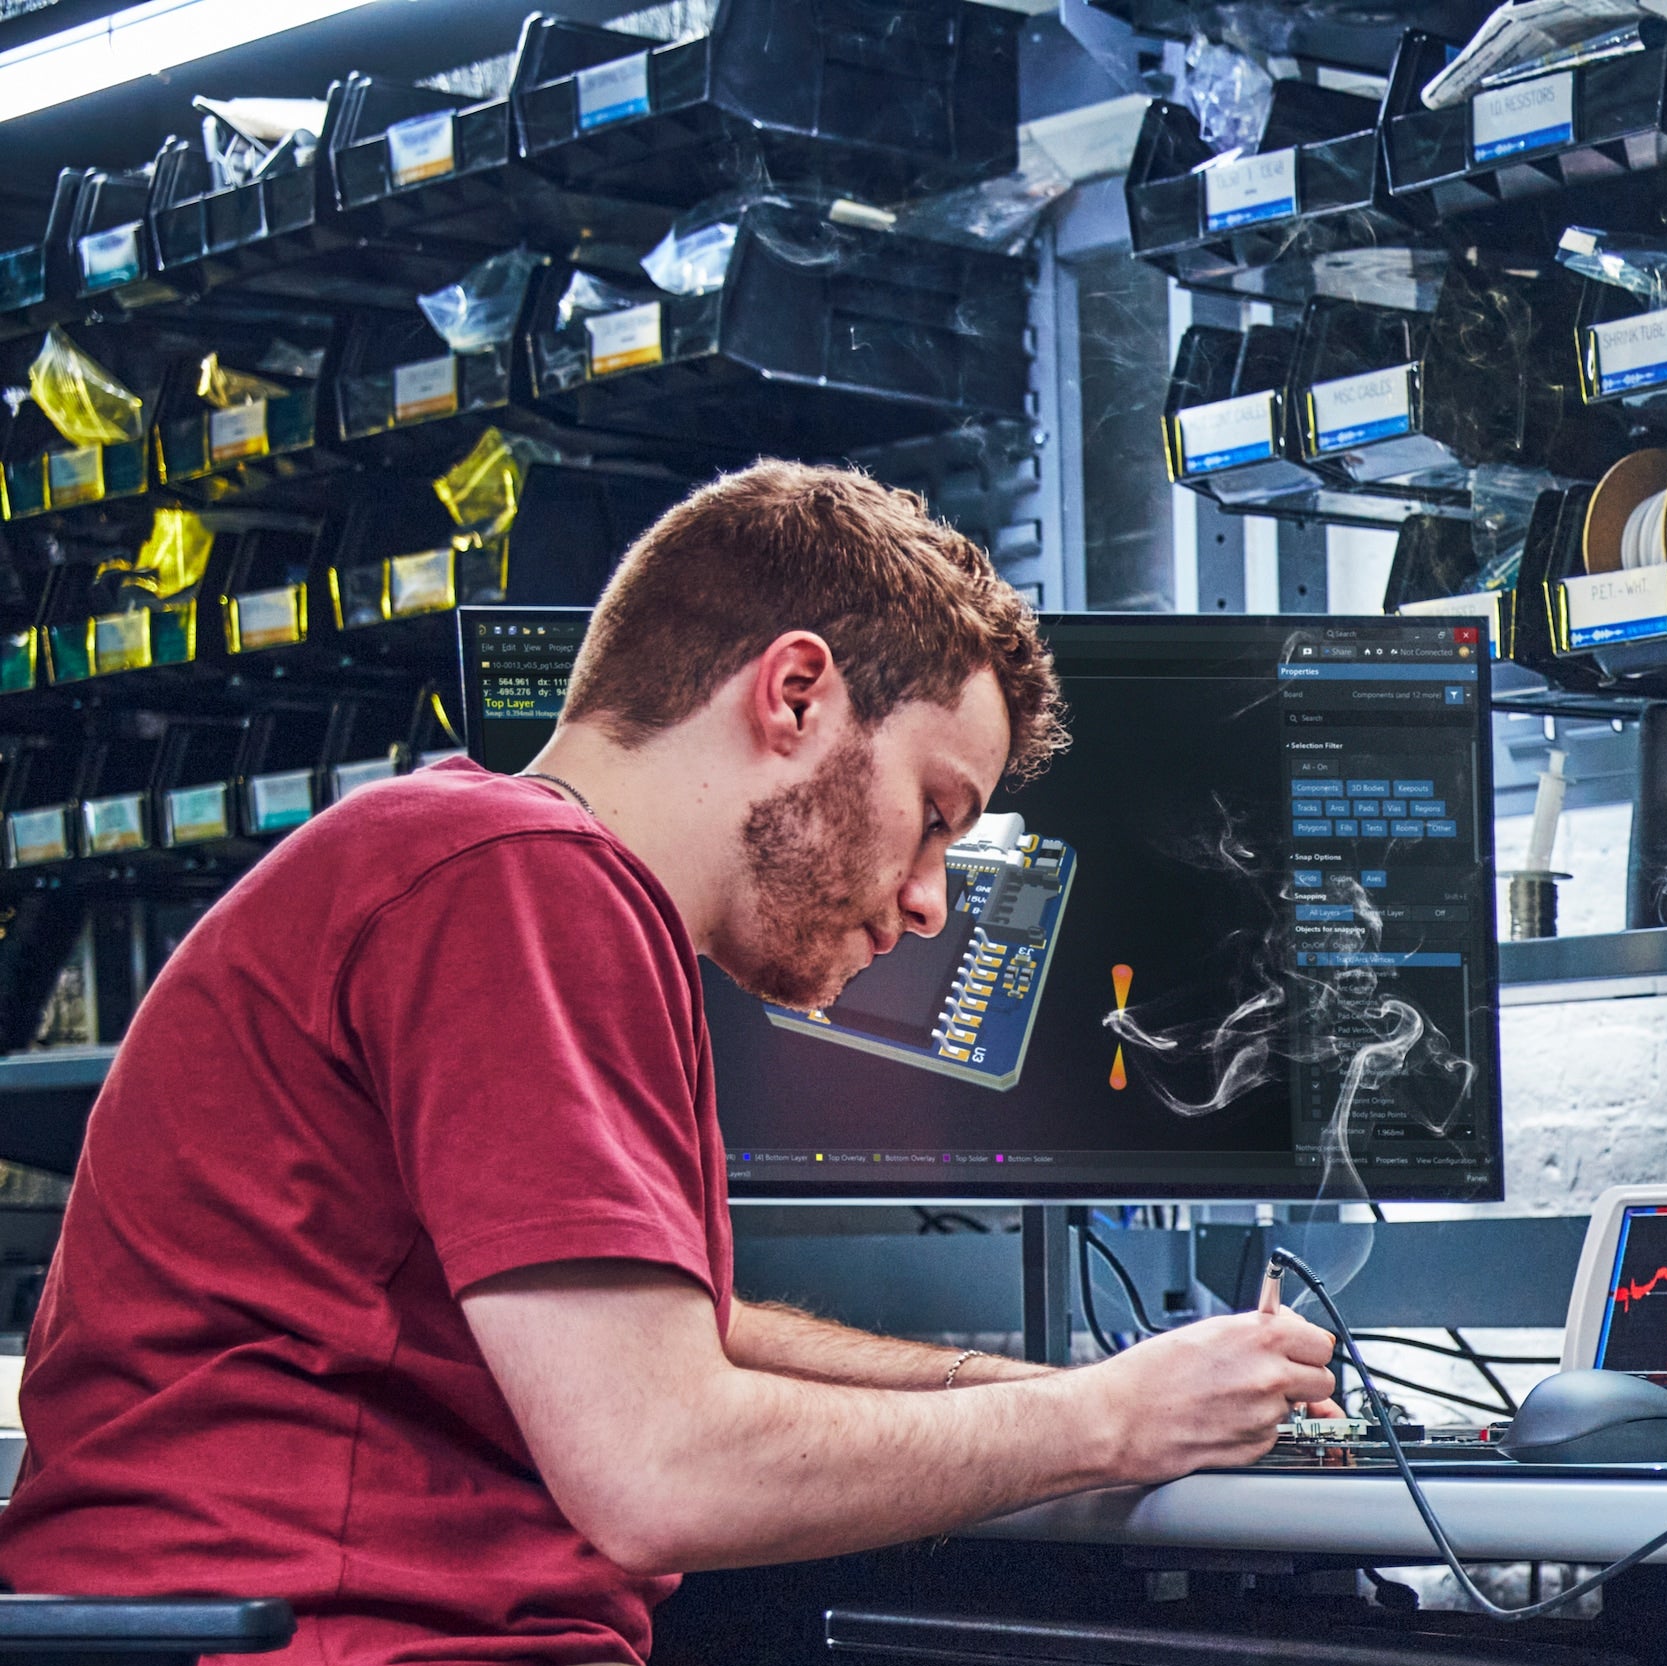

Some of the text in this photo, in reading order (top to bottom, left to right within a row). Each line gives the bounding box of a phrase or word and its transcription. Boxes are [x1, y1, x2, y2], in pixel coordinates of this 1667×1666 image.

[1602, 328, 1638, 350] SHRINK
[1640, 321, 1665, 340] TUBE
[1335, 630, 1357, 638] Search
[481, 643, 574, 653] File Edit View Project
[1332, 648, 1352, 656] Share
[1414, 648, 1453, 657] Connected
[1280, 667, 1320, 677] Properties
[1352, 691, 1395, 699] Components
[1395, 691, 1411, 699] (and
[1421, 691, 1442, 699] more)
[485, 697, 535, 710] Top Layer
[1301, 714, 1323, 722] Search
[1291, 742, 1344, 750] Selection Filter
[1302, 763, 1328, 771] All On
[1297, 785, 1339, 794] Components
[1398, 785, 1429, 794] Keepouts
[1297, 804, 1317, 812] Tracks
[1330, 804, 1345, 812] Arcs
[1358, 804, 1375, 812] Pads
[1387, 804, 1401, 812] Vias
[1415, 805, 1441, 814] Regions
[1297, 824, 1328, 833] Polygons
[1340, 824, 1353, 832] Fills
[1396, 824, 1419, 832] Rooms
[1432, 824, 1452, 832] Other
[1294, 853, 1342, 862] Snap Options
[1300, 875, 1317, 883] Grids
[1366, 875, 1382, 883] Axes
[1294, 893, 1327, 901] Snapping
[1309, 909, 1341, 918] All Layers
[1387, 909, 1405, 918] Layer
[1434, 909, 1446, 917] Off
[1295, 925, 1366, 935] Objects for snapping
[971, 1046, 987, 1064] U3
[1371, 1097, 1395, 1105] Origins
[1352, 1111, 1407, 1120] Body Snap Points
[1295, 1144, 1322, 1153] Nothing
[790, 1154, 808, 1163] Layer
[828, 1154, 867, 1163] Top Overlay
[885, 1154, 936, 1163] Bottom Overlay
[955, 1154, 989, 1163] Top Solder
[1375, 1156, 1409, 1166] Properties
[1433, 1156, 1477, 1165] Configuration
[1466, 1174, 1488, 1183] Panels
